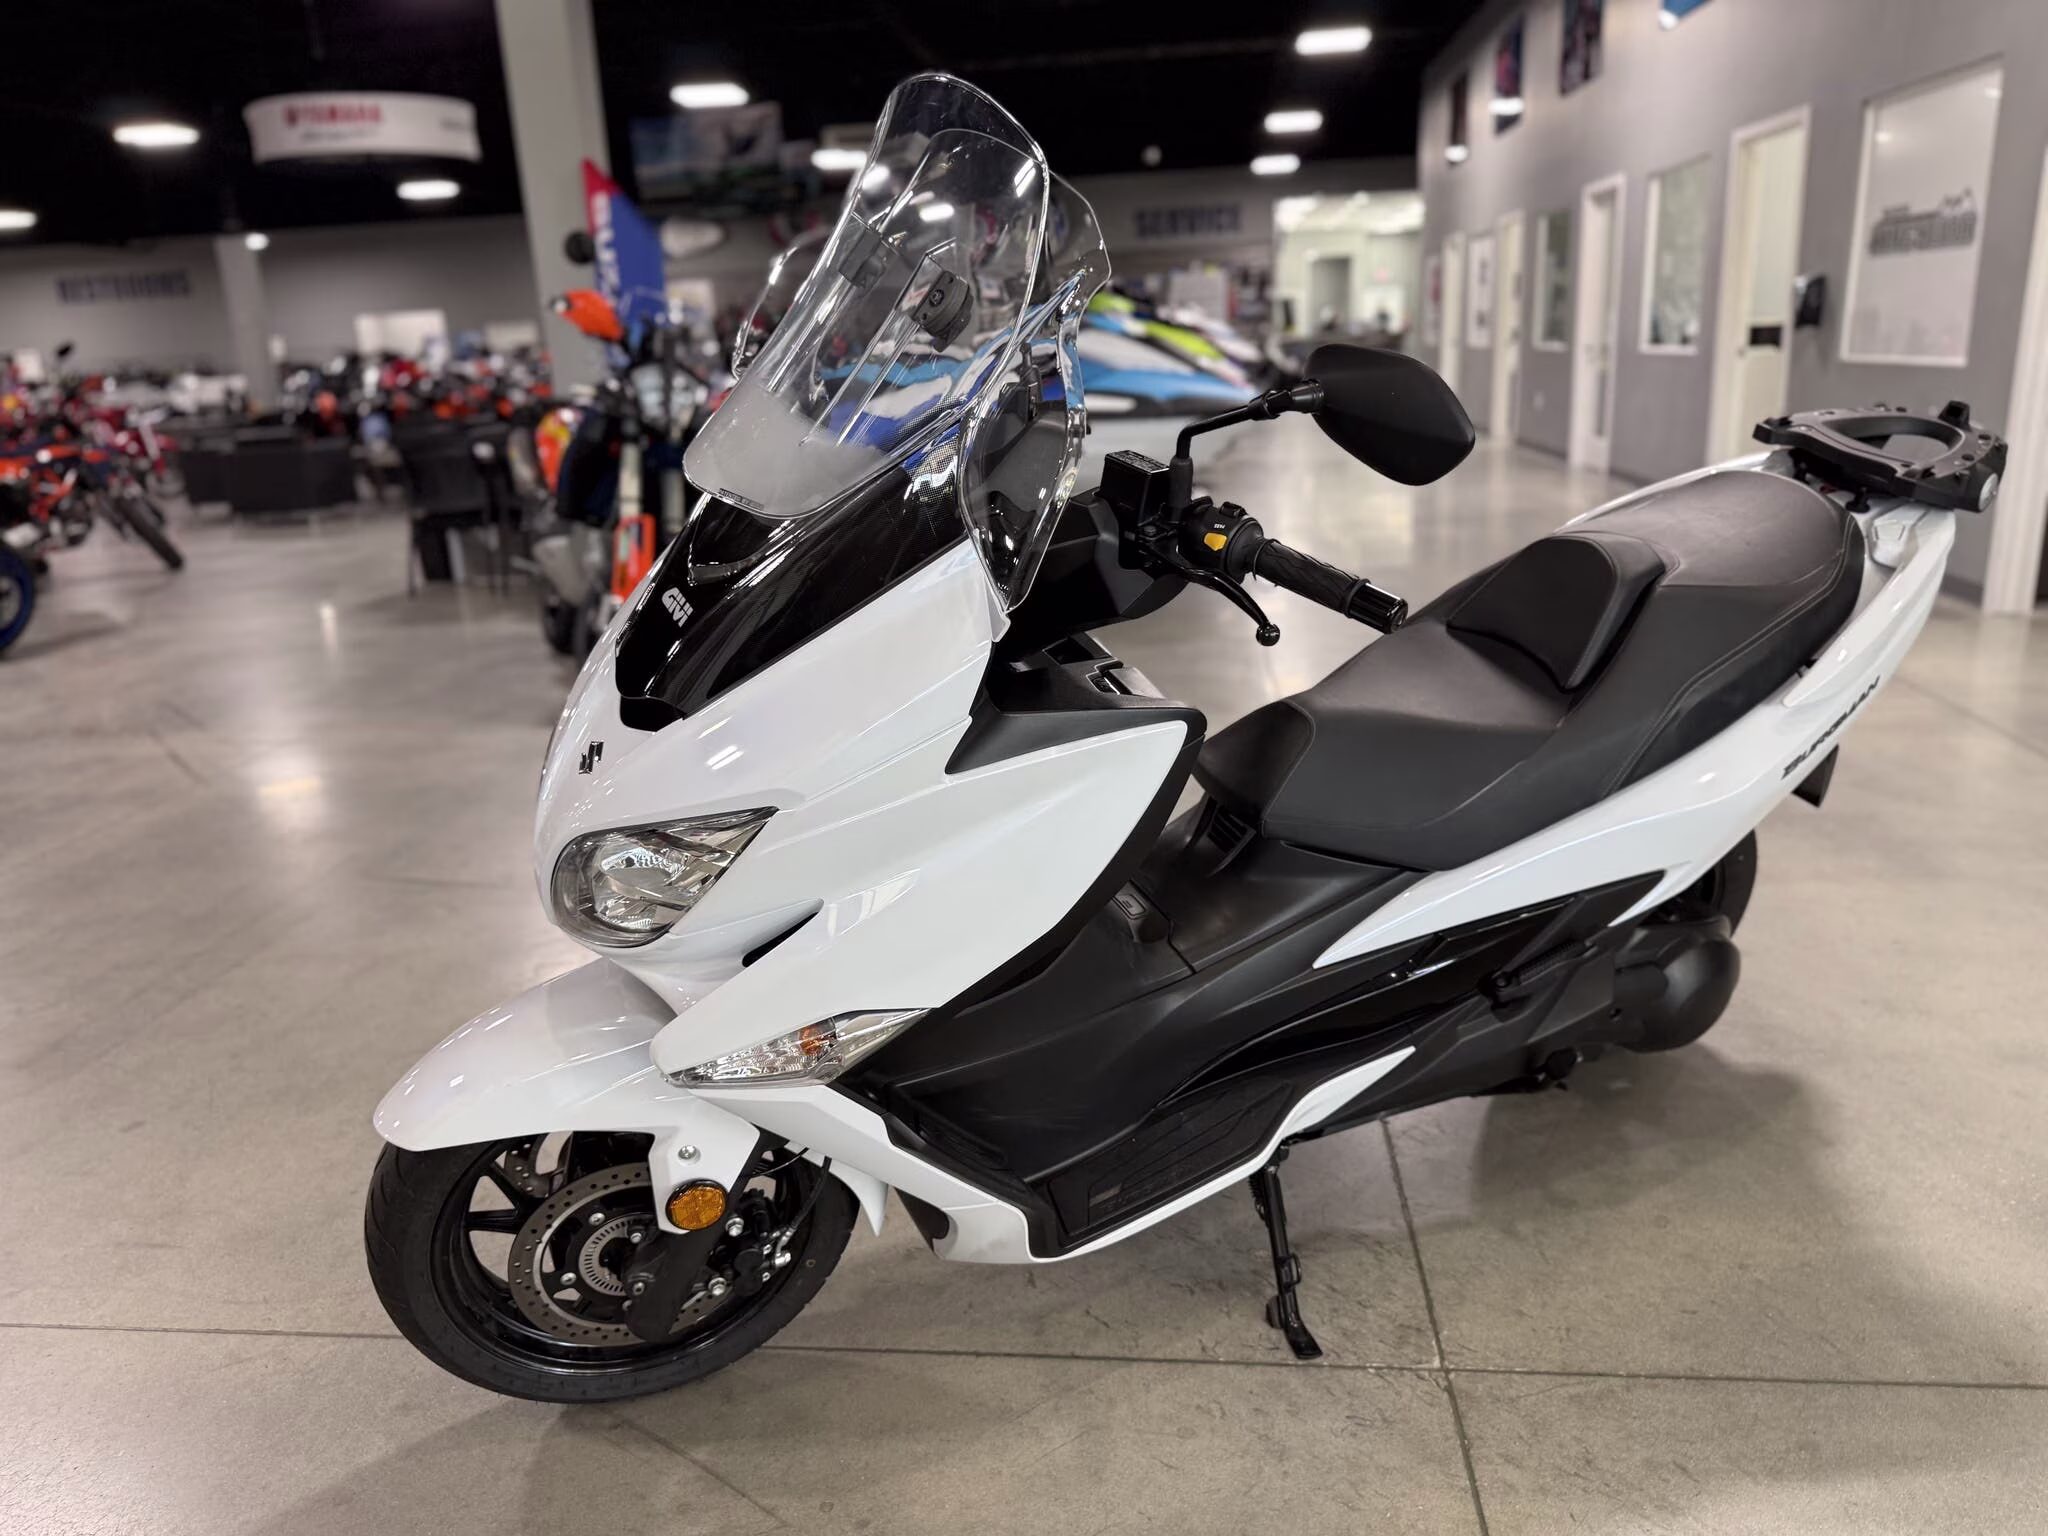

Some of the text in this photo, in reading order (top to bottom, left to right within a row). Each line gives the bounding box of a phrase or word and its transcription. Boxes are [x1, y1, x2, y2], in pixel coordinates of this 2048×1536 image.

[1135, 207, 1240, 237] SERVICE
[56, 273, 191, 304] RESTROOMS
[661, 587, 694, 628] GIVI
